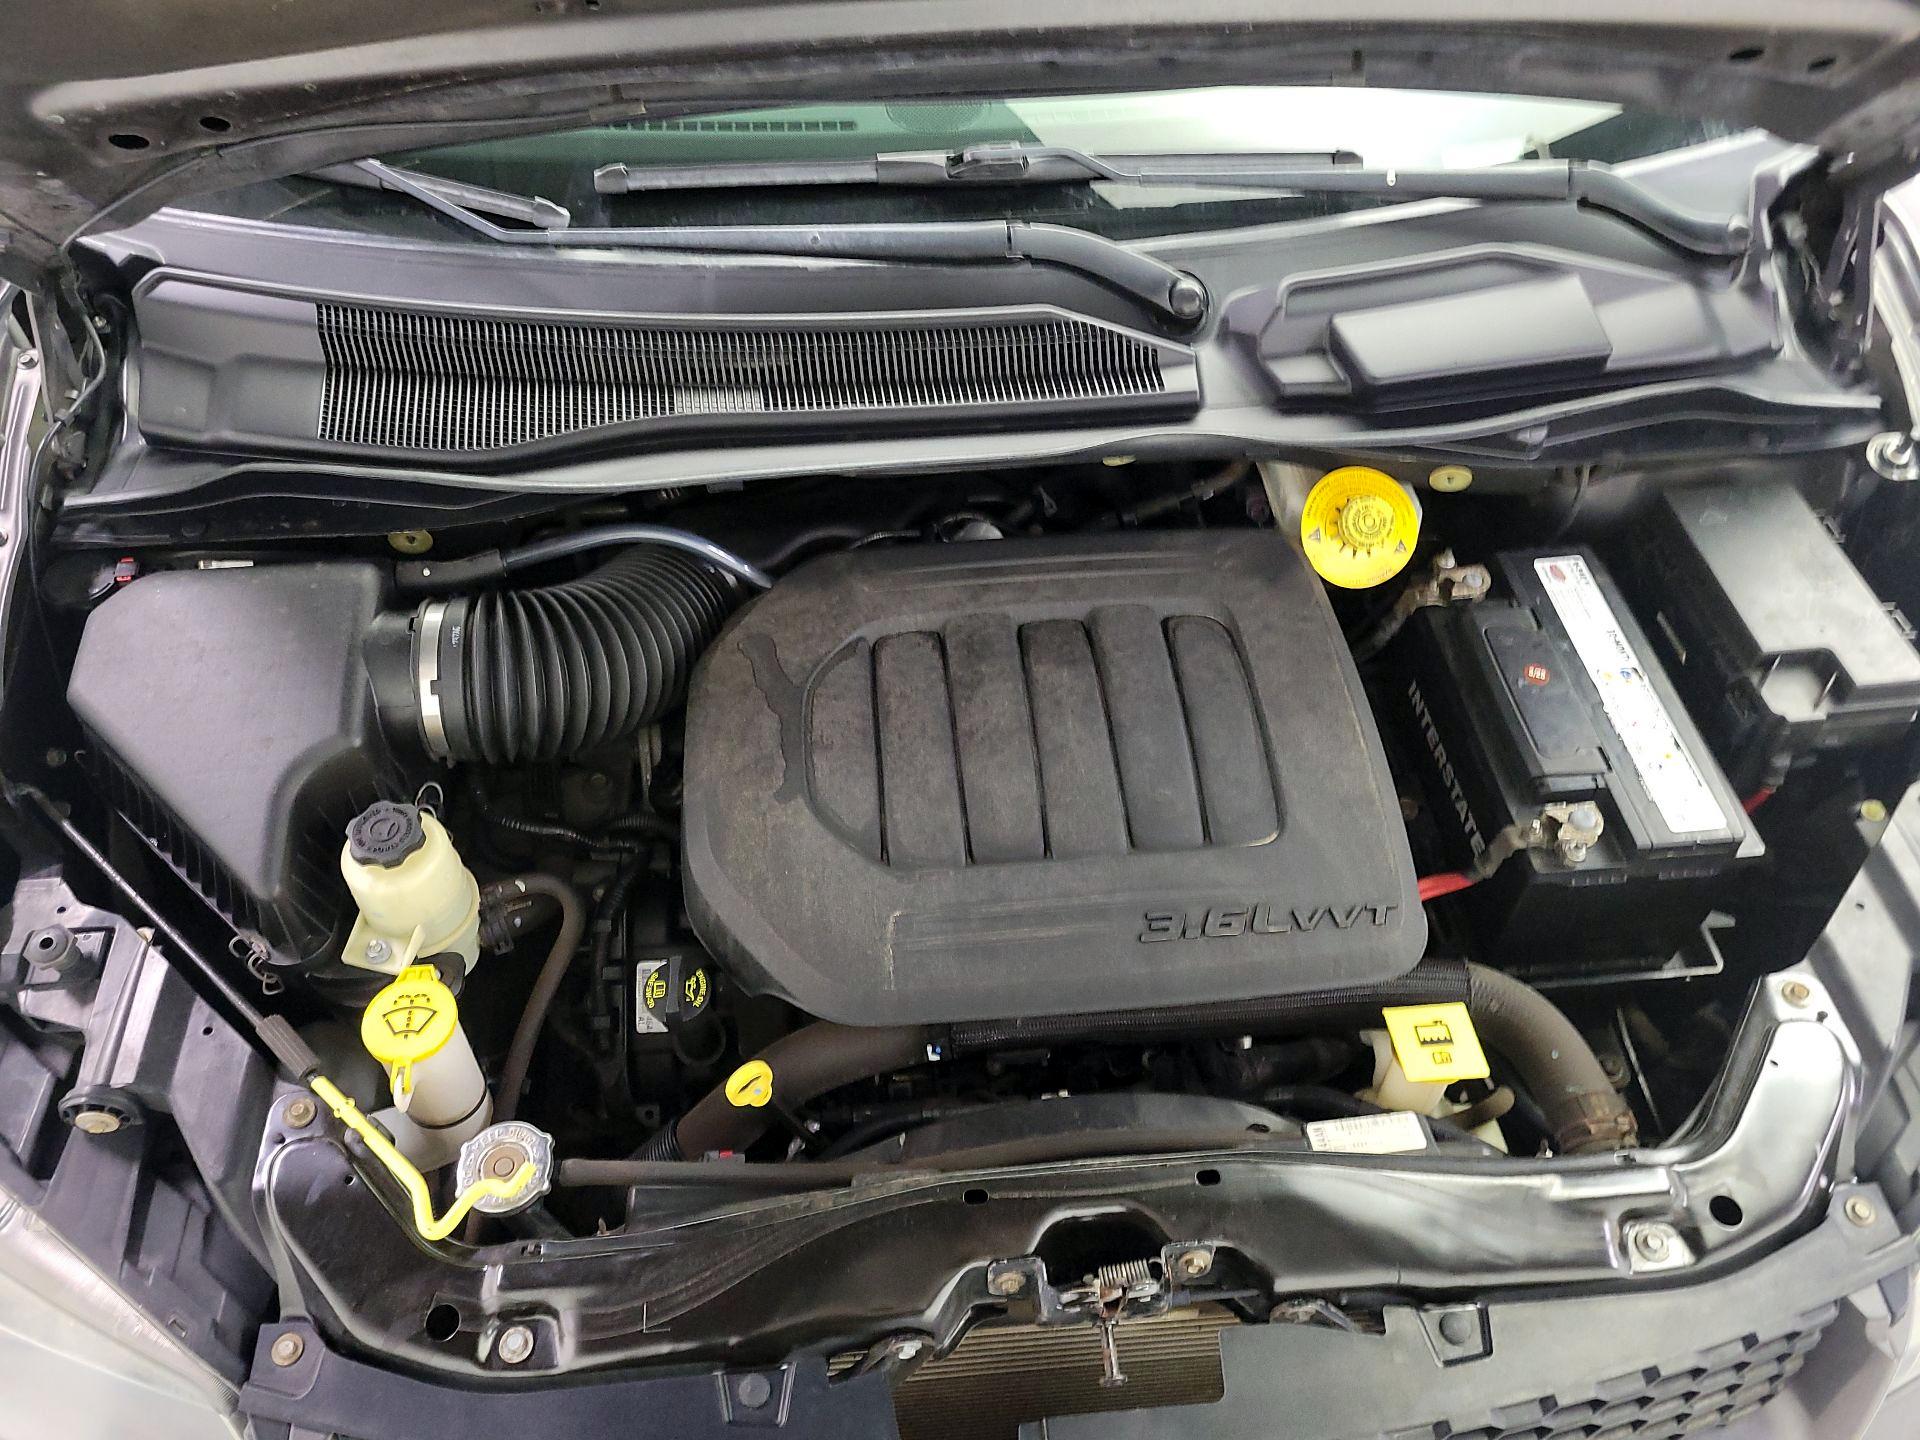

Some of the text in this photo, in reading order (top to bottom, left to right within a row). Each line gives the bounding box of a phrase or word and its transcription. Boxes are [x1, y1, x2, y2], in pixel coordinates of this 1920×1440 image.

[1408, 678, 1486, 858] INTERSTATE
[693, 968, 706, 1007] ENGINE OIL
